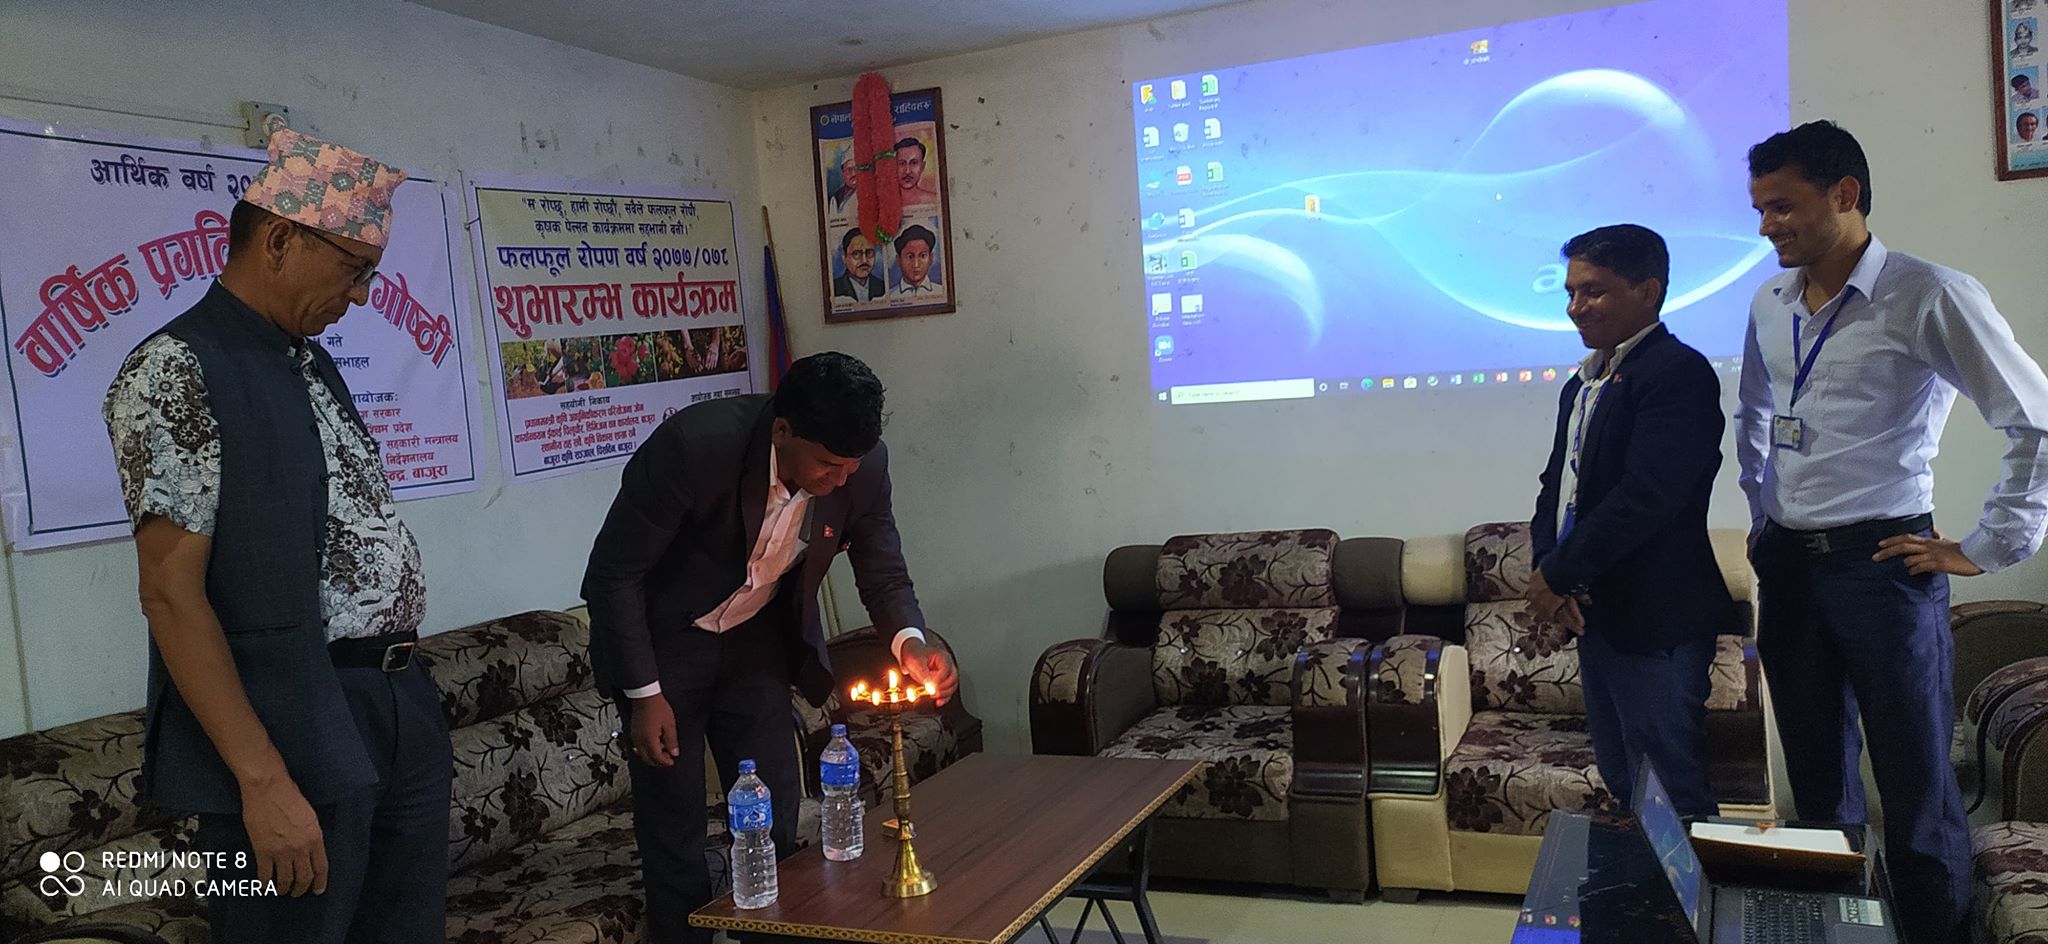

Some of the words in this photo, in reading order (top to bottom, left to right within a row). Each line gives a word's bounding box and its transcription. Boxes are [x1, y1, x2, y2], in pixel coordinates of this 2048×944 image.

[91, 154, 170, 186] आर्थिक
[179, 164, 216, 192] वर्ष
[227, 173, 252, 200] २०
[569, 197, 589, 214] हामी
[497, 246, 571, 277] फलफूल
[578, 240, 620, 268] रोपण
[624, 241, 648, 267] वर्ष
[653, 246, 729, 272] २०७७/०७८
[14, 252, 139, 378] वार्षिक
[371, 271, 455, 369] गोष्ठी
[494, 282, 623, 338] शुभारम्भ
[631, 271, 738, 321] कार्यक्रम
[326, 333, 343, 348] गते
[386, 435, 420, 449] सहकारी
[412, 465, 448, 480] बाजुरा
